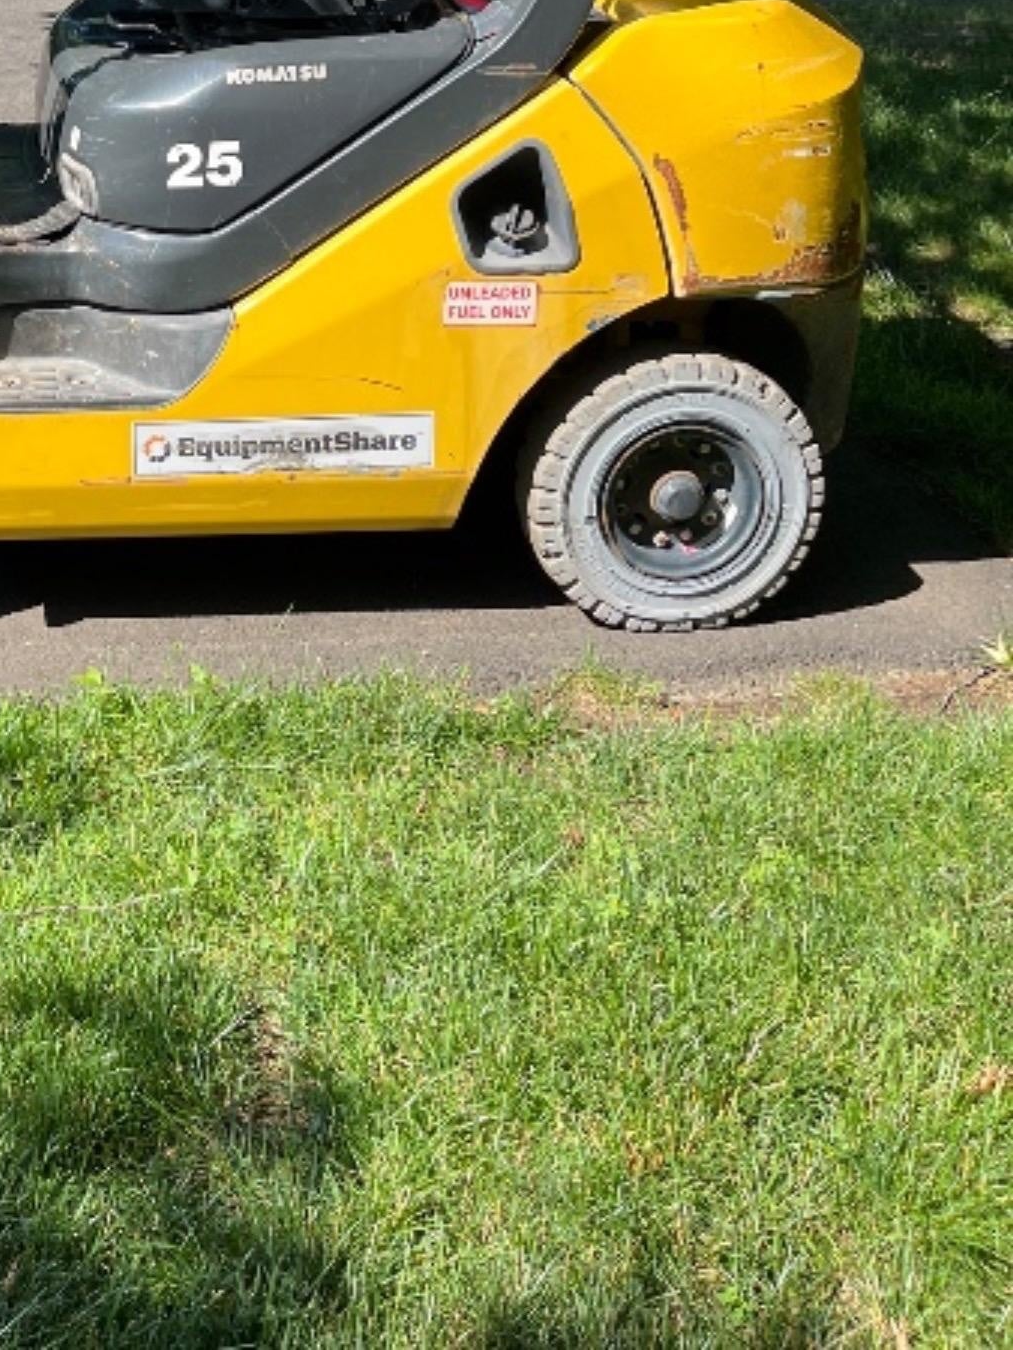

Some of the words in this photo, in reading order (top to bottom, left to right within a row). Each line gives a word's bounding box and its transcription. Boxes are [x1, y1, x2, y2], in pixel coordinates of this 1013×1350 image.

[226, 62, 328, 85] KOMATSU
[165, 139, 244, 191] 25
[447, 286, 532, 301] UNLEADED
[447, 305, 486, 319] FUEL
[491, 305, 532, 319] ONLY
[176, 430, 419, 463] EquipmentShare
